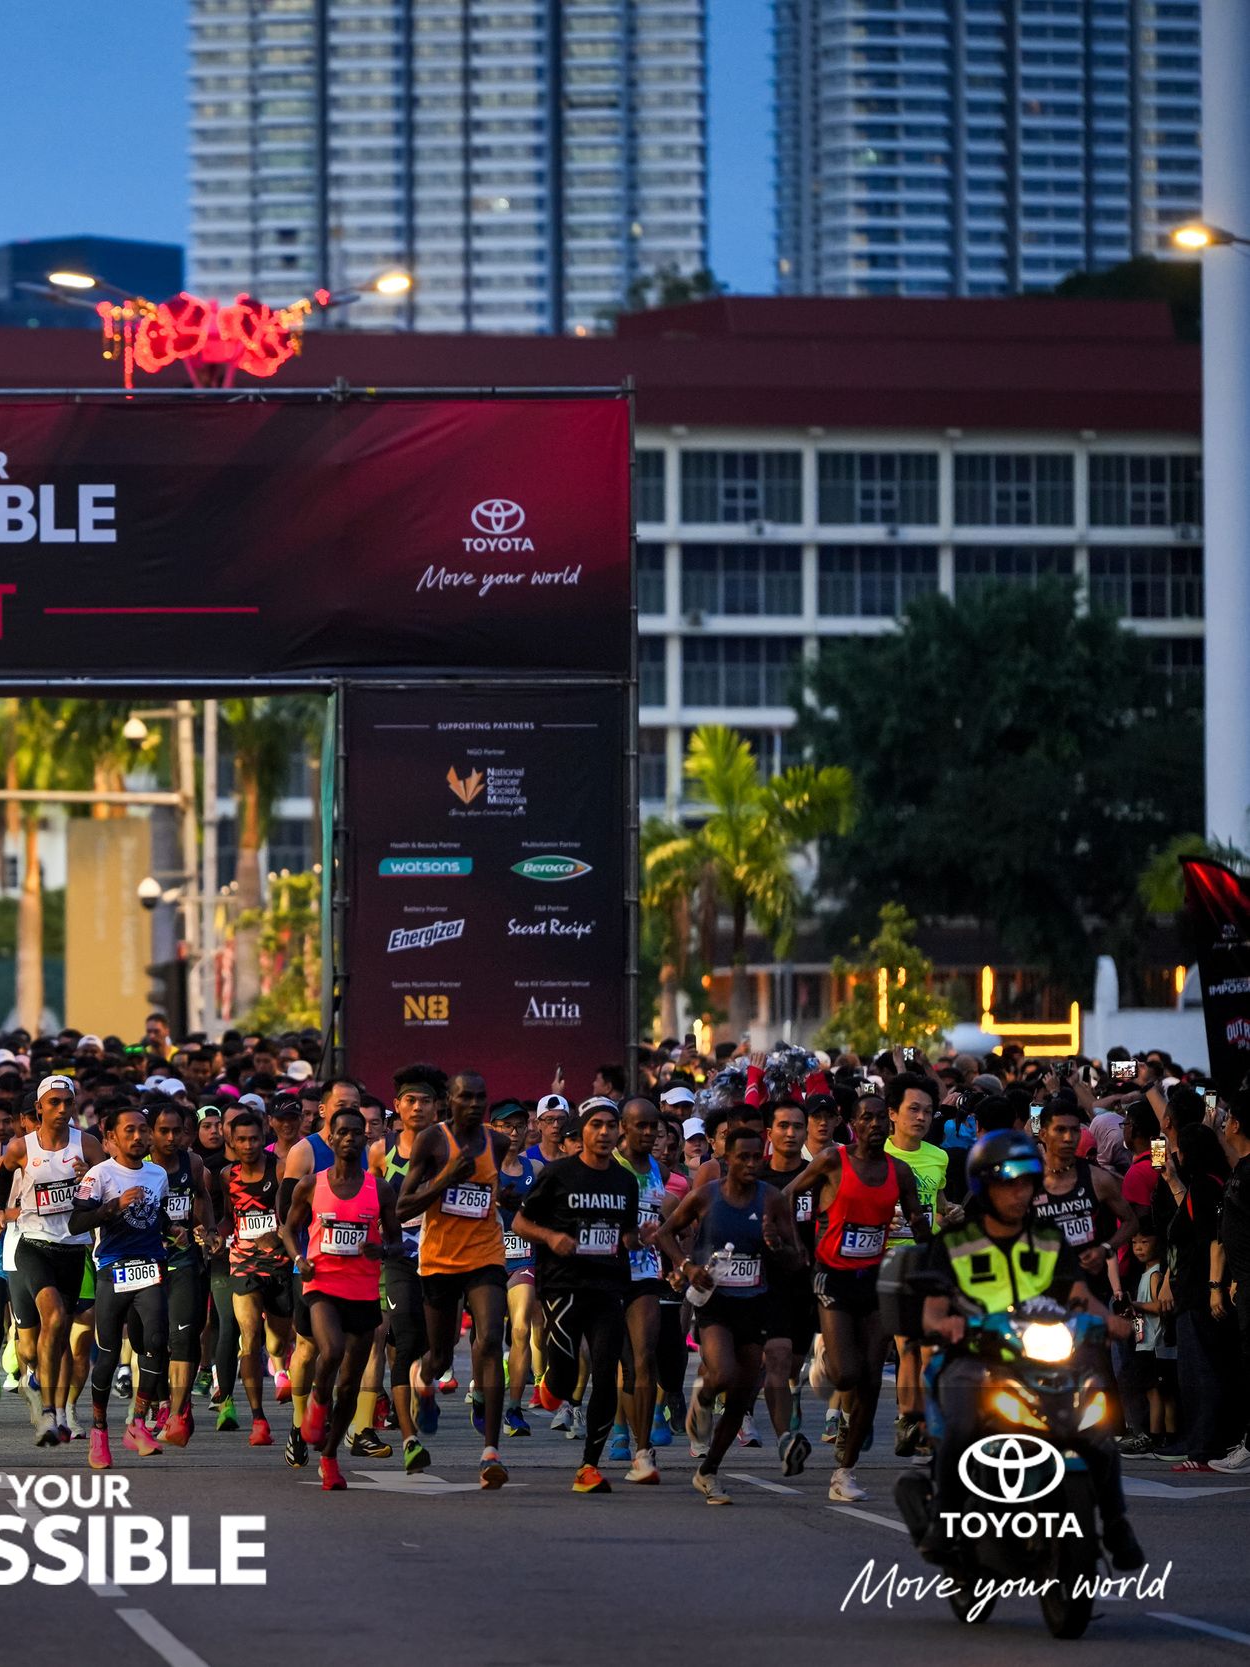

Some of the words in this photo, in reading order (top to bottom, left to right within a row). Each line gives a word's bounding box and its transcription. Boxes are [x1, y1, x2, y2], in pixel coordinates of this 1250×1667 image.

[461, 537, 535, 552] TOYOTA
[415, 564, 477, 592] Move
[478, 572, 526, 597] your
[530, 563, 582, 586] world
[437, 722, 491, 730] SUPPORTING
[492, 722, 535, 730] PARTNERS
[487, 767, 525, 777] National
[487, 776, 520, 786] Cancer
[487, 785, 521, 796] Society
[487, 795, 527, 805] Malaysia
[390, 861, 461, 873] watsons
[522, 862, 575, 873] Berocca
[389, 920, 463, 950] Energizer
[507, 918, 547, 935] Secret
[549, 918, 592, 939] Recipe
[404, 994, 449, 1020] N8
[524, 995, 581, 1019] Atria
[39, 1191, 48, 1207] A
[445, 1188, 456, 1204] E
[458, 1190, 488, 1208] 2658
[567, 1192, 627, 1210] CHARLIE
[1036, 1198, 1093, 1218] MALAYSIA
[239, 1216, 246, 1231] A
[248, 1215, 273, 1230] 0072
[322, 1229, 331, 1244] A
[334, 1229, 365, 1245] 0082
[579, 1228, 588, 1245] C
[594, 1229, 617, 1245] 1036
[845, 1231, 854, 1248] E
[115, 1268, 125, 1284] E
[128, 1264, 156, 1281] 3066
[731, 1261, 758, 1277] 2607
